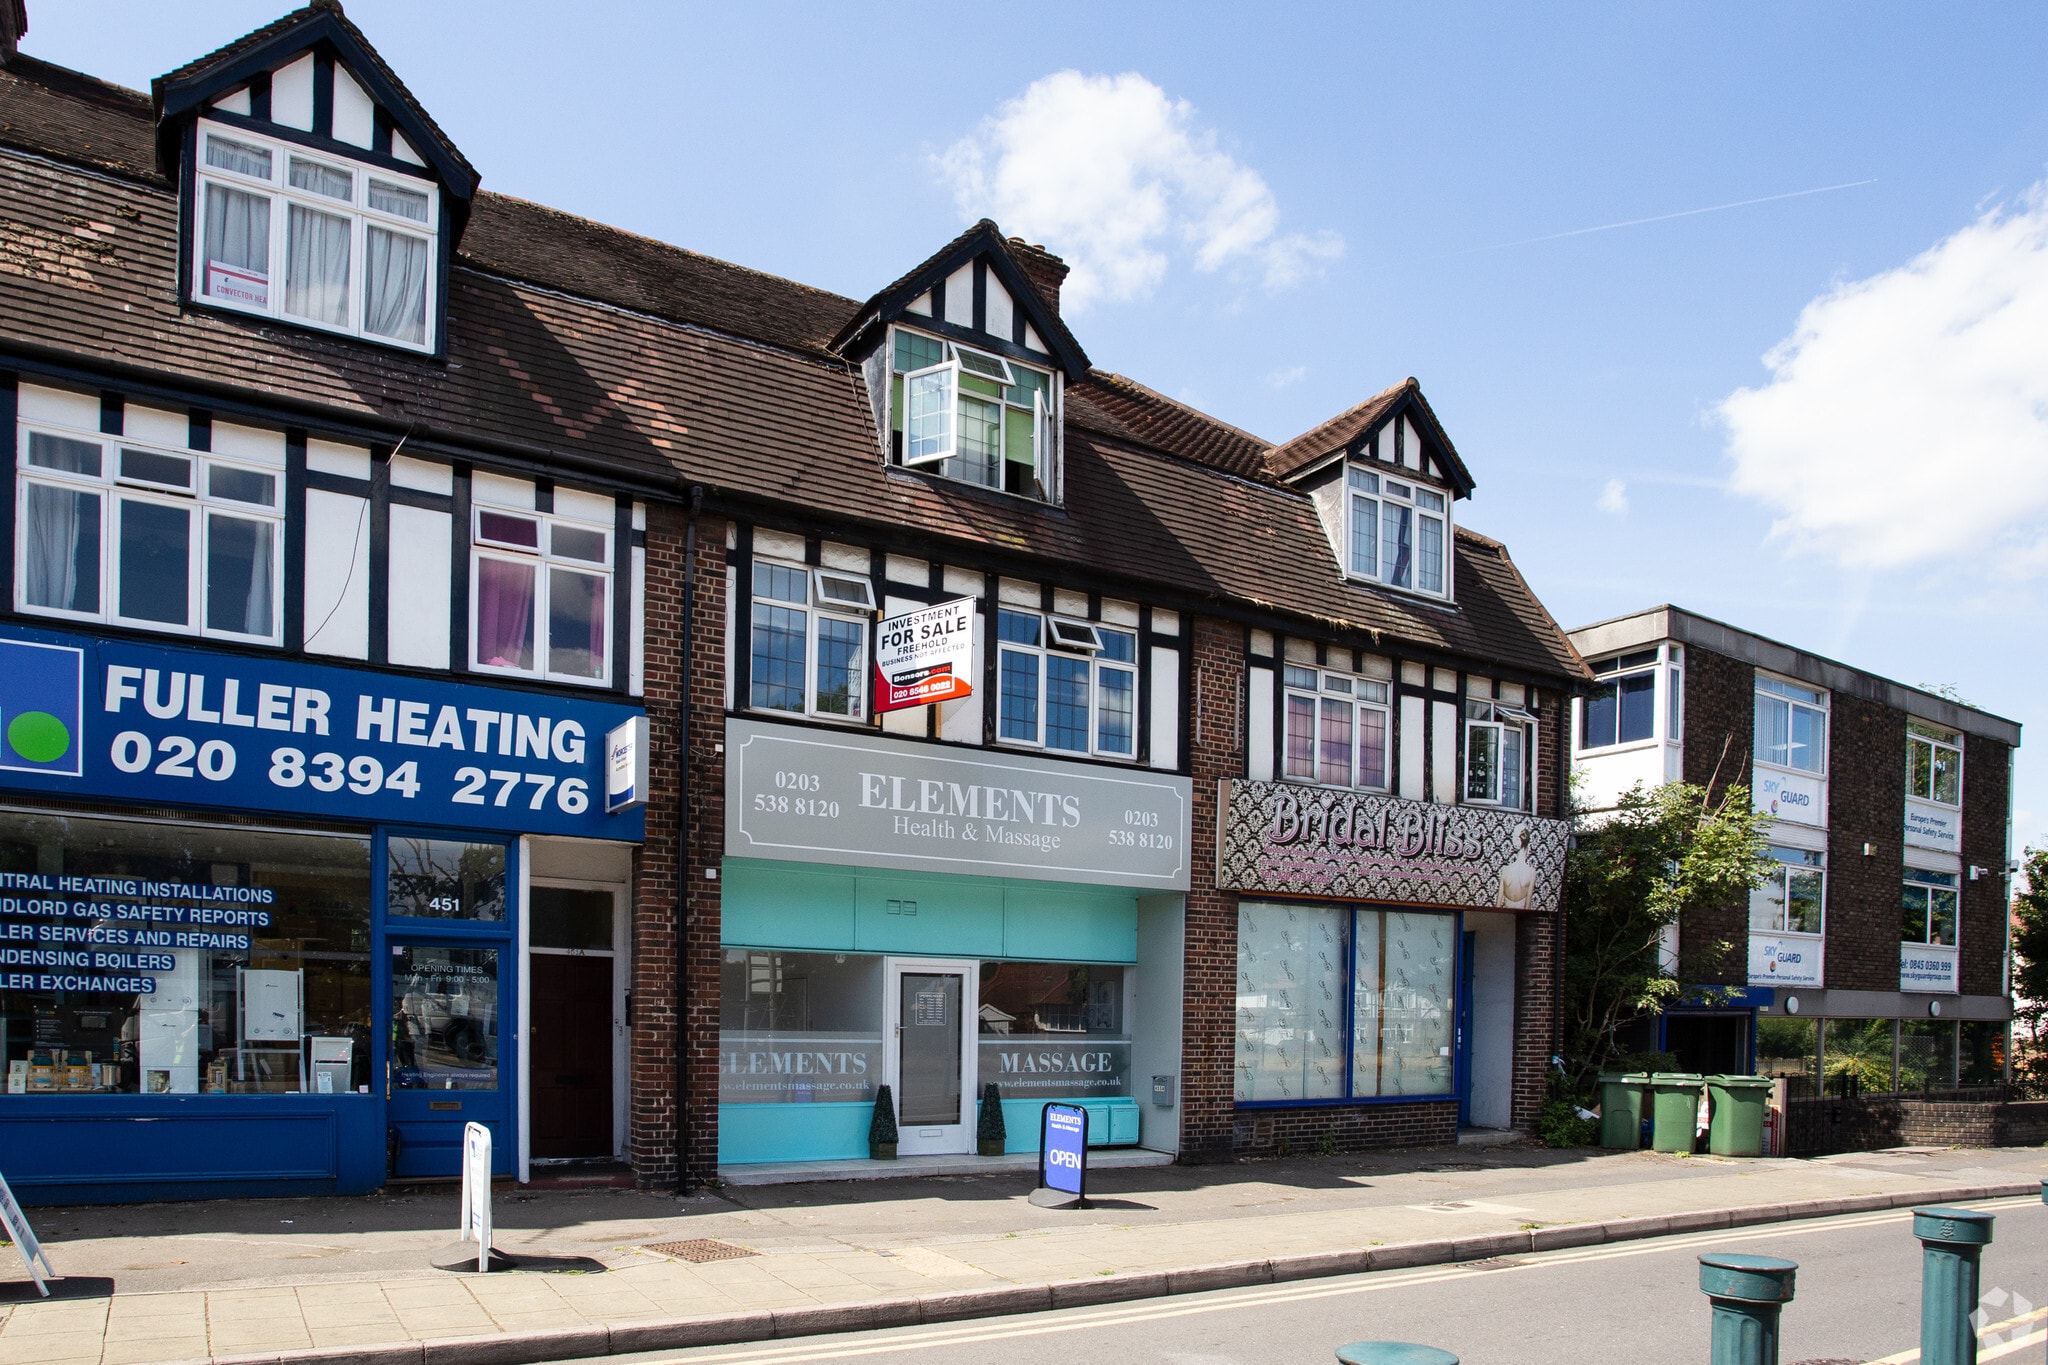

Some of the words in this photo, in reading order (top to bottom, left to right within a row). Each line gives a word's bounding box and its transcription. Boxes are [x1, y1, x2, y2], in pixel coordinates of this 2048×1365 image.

[216, 285, 253, 301] CONVECTOR
[888, 605, 960, 632] INVESTMENT
[881, 628, 914, 650] FOR
[920, 616, 967, 639] SALE
[881, 654, 913, 667] BUSINESS
[914, 650, 928, 660] NOT
[930, 643, 965, 656] AFFECTED
[897, 637, 948, 656] FREEHOLD
[893, 665, 951, 682] Bonsors.com
[893, 689, 908, 699] 020
[105, 664, 331, 736] FULLER
[356, 694, 586, 764] HEATING
[110, 730, 237, 782] 020
[268, 747, 421, 799] 8394
[451, 766, 590, 815] 2776
[774, 770, 820, 792] 0203
[1763, 780, 1780, 794] SKY
[753, 793, 790, 814] 538
[794, 797, 840, 819] 8120
[858, 772, 1081, 829] ELEMENTS
[1780, 790, 1810, 807] GUARD
[1124, 809, 1159, 828] 0203
[1265, 791, 1389, 848] Bridal
[1394, 808, 1483, 859] Bliss
[892, 815, 956, 839] Health
[961, 822, 980, 842] &
[985, 824, 1061, 853] Massage
[1108, 829, 1135, 847] 538
[1138, 832, 1173, 850] 8120
[1922, 827, 1937, 839] Safety
[1938, 829, 1954, 841] Service
[0, 873, 53, 890] TRAL
[58, 876, 137, 895] HEATING
[142, 881, 273, 904] INSTALLATIONS
[0, 898, 68, 916] DLORD
[73, 902, 111, 918] GAS
[116, 904, 184, 922] SAFETY
[189, 908, 269, 926] REPORTS
[429, 897, 460, 912] 451
[39, 926, 129, 945] SERVICES
[133, 931, 171, 946] AND
[176, 933, 248, 949] REPAIRS
[1763, 945, 1778, 957] SKY
[1777, 952, 1802, 964] GUARD
[95, 952, 172, 970] BOILERS
[410, 963, 454, 973] OPENING
[455, 965, 484, 974] TIMES
[1909, 959, 1925, 970] 0845
[1940, 961, 1952, 972] 999
[40, 975, 153, 993] EXCHANGES
[430, 974, 442, 982] Fri
[445, 975, 464, 983] 9:00
[471, 976, 490, 984] 5:00
[999, 1052, 1112, 1074] MASSAGE
[1050, 1113, 1081, 1125] ELEMENTS
[1050, 1149, 1080, 1169] OPEN
